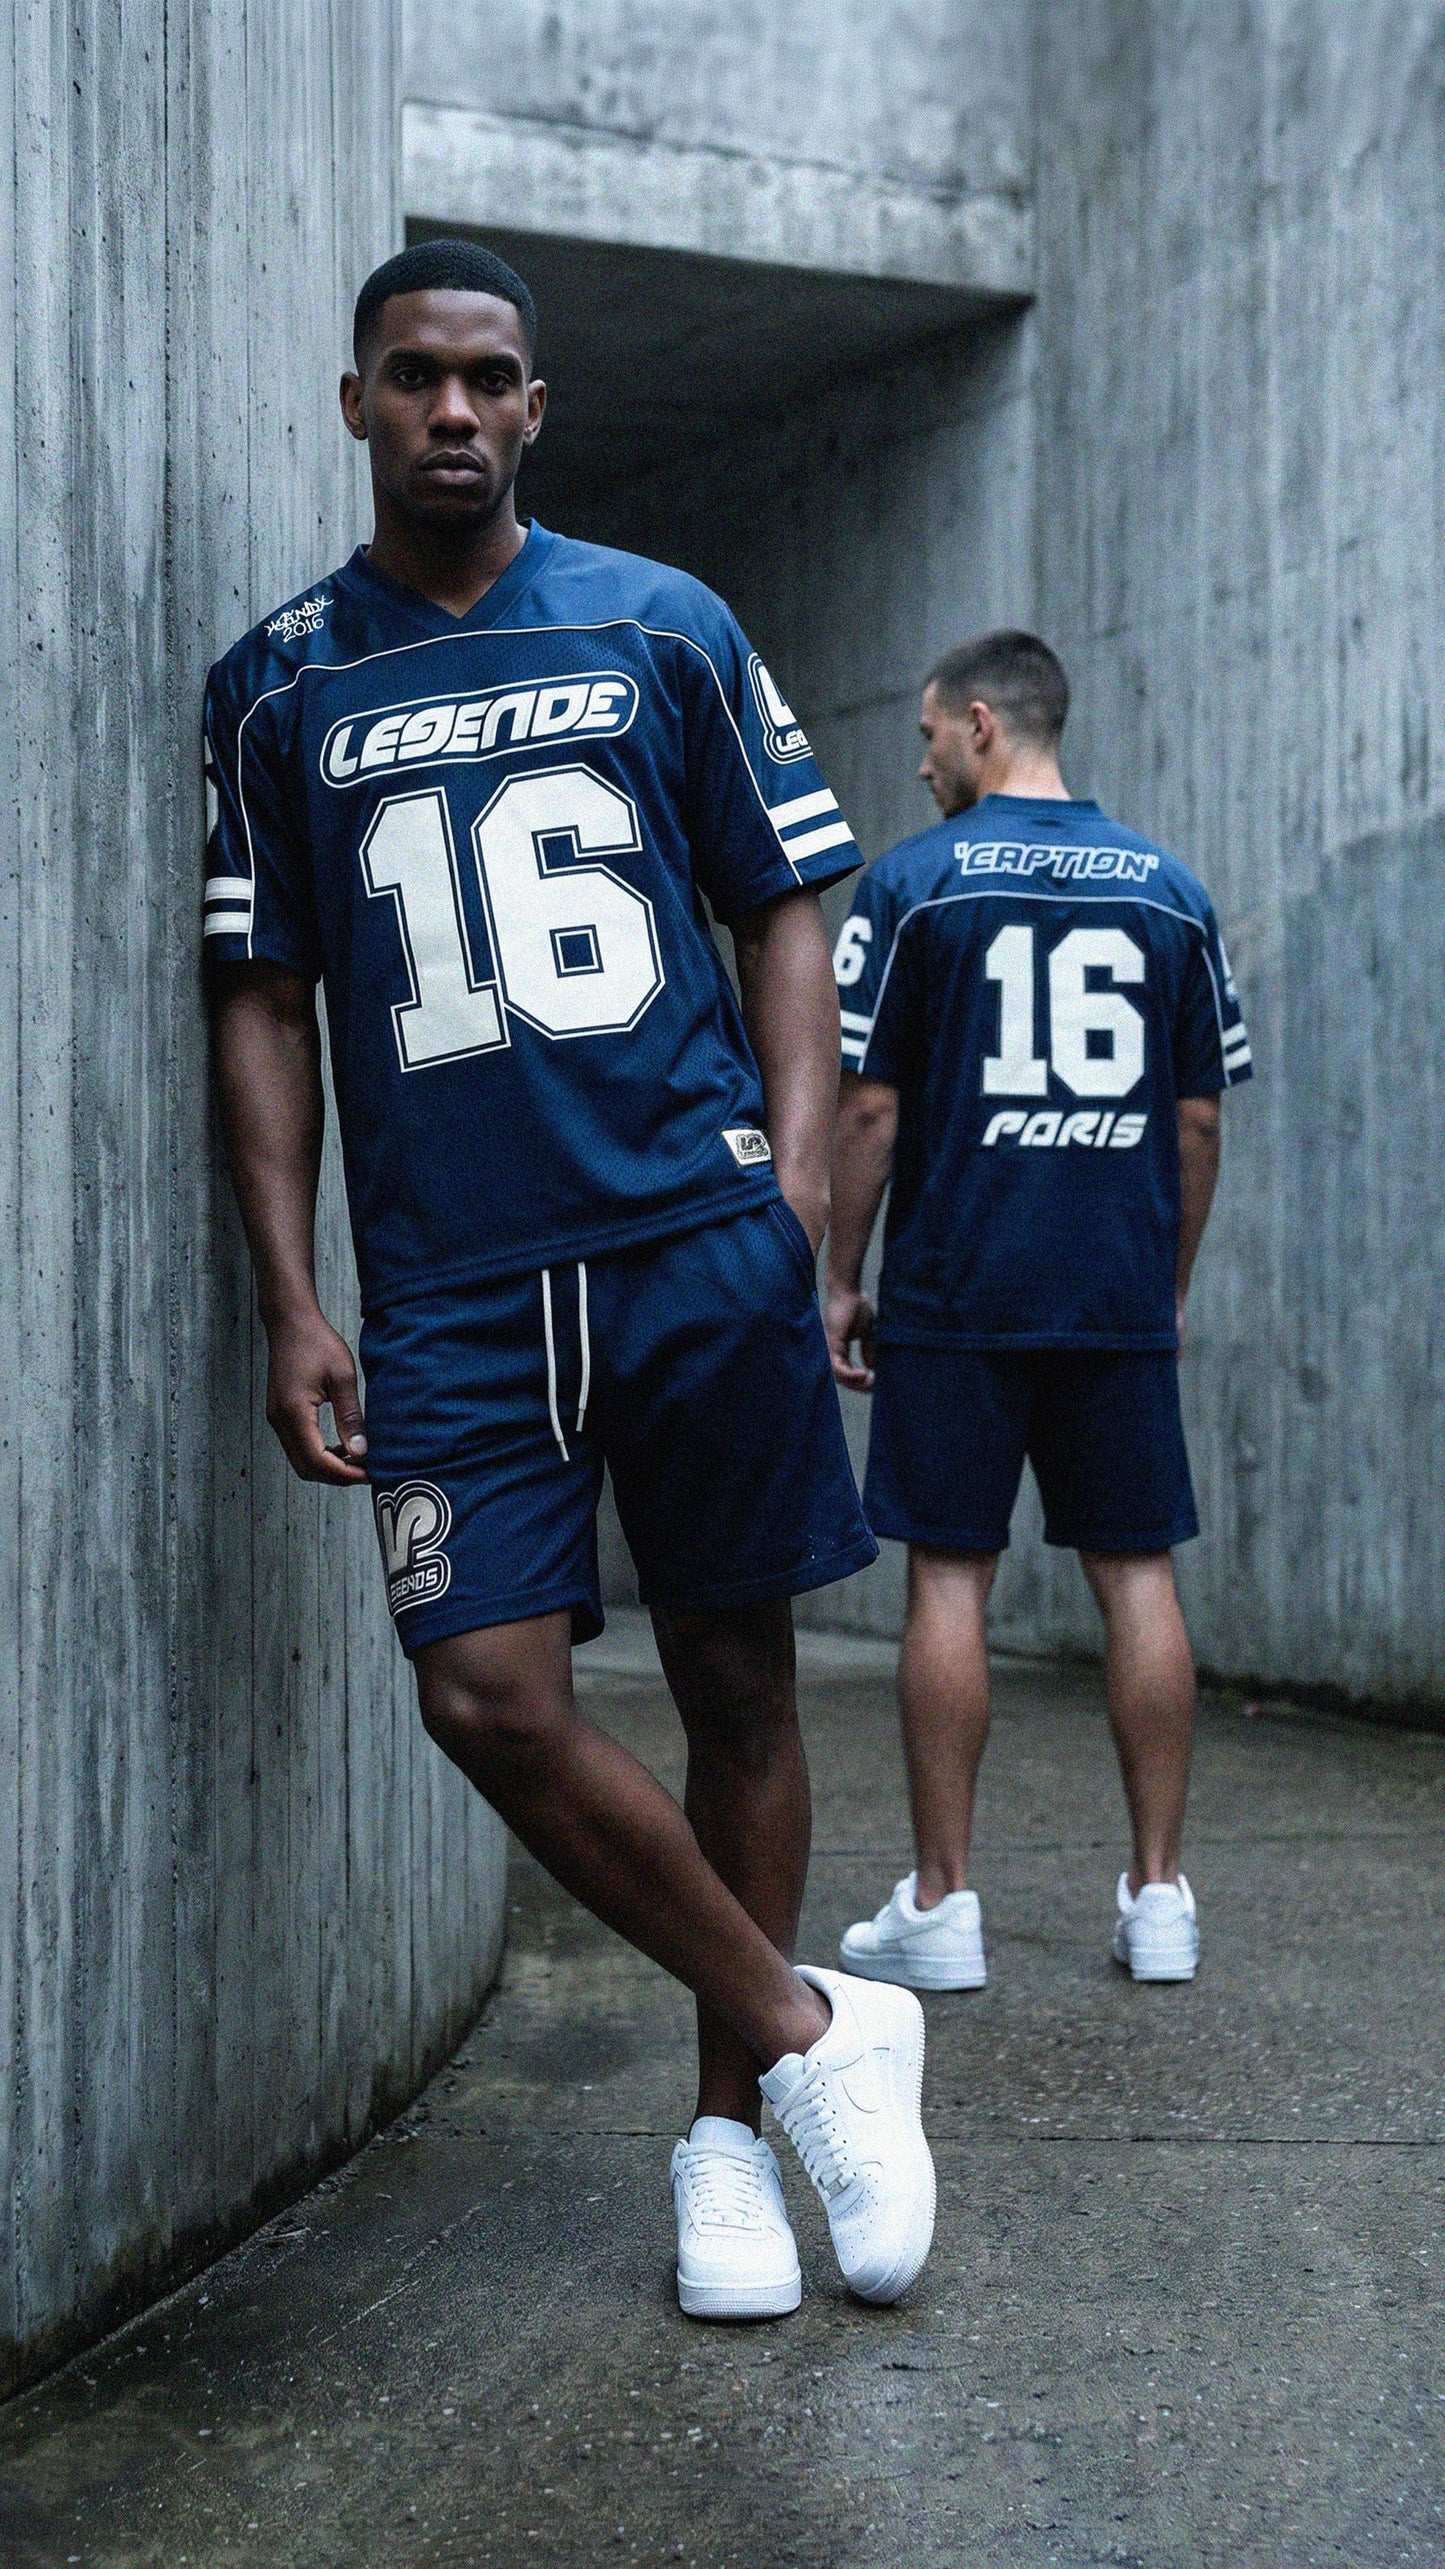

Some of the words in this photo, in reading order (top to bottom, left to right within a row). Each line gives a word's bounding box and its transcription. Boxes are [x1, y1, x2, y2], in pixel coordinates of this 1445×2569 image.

[283, 613, 324, 643] 2016
[329, 682, 628, 777] LEGENDE
[359, 763, 665, 1073] 16
[983, 924, 1146, 1097] 16
[981, 1110, 1148, 1148] PARIS
